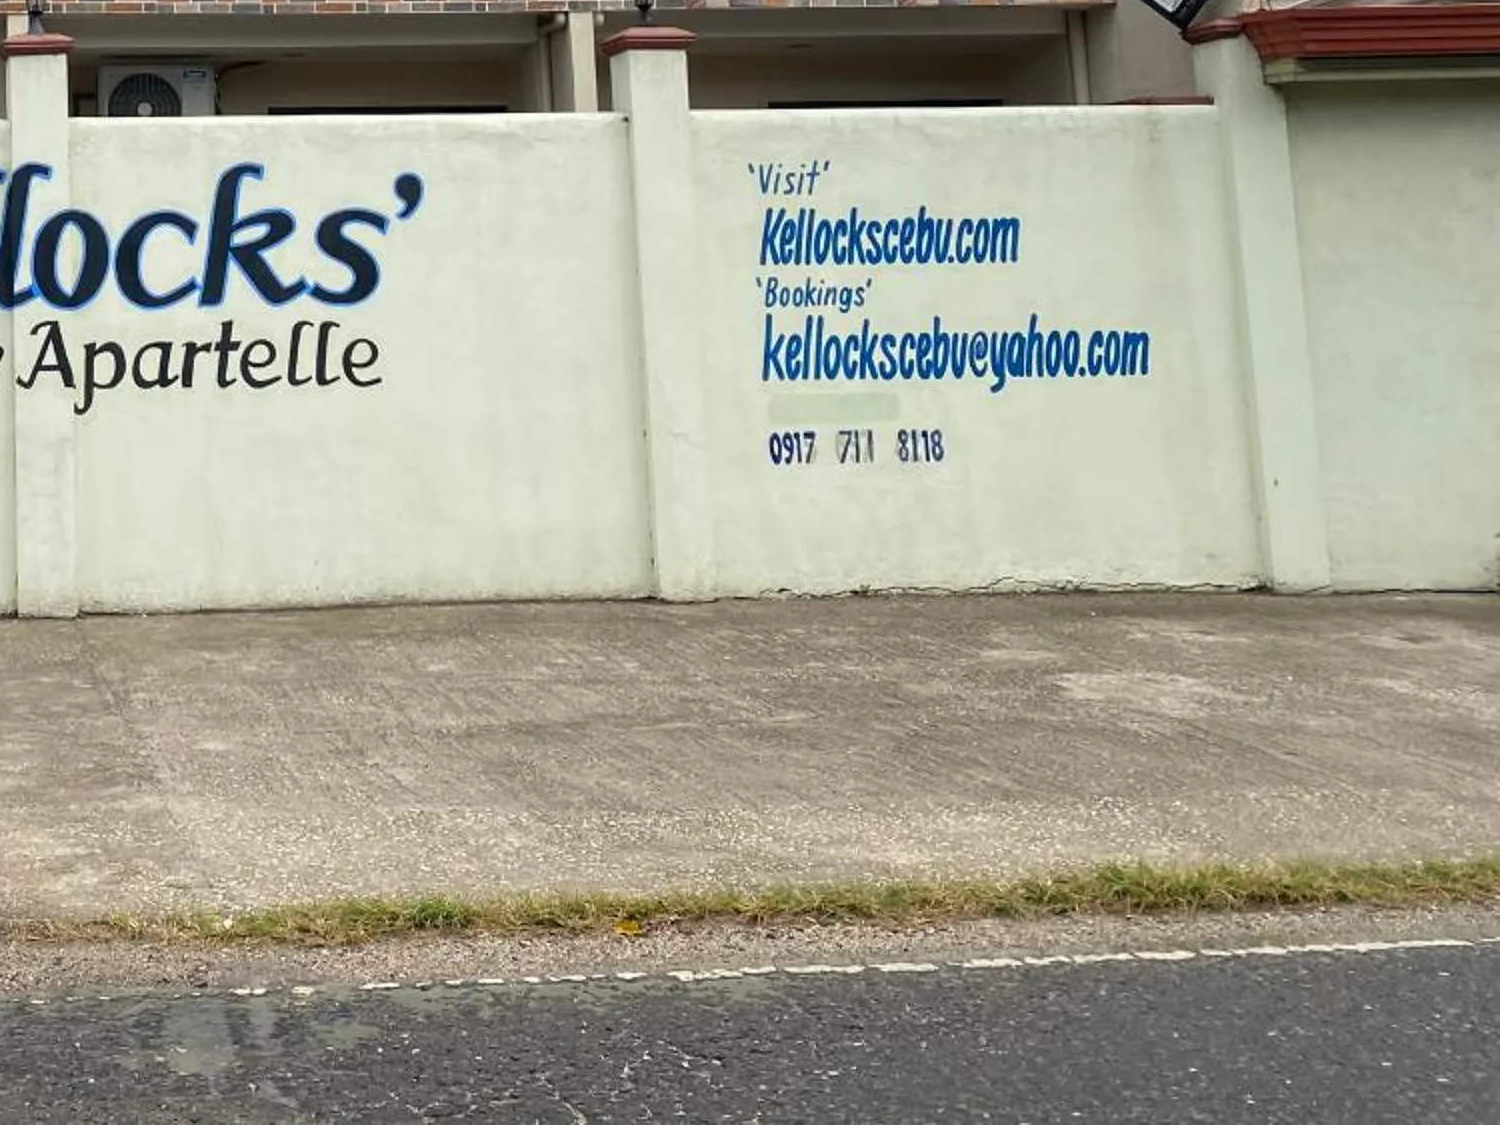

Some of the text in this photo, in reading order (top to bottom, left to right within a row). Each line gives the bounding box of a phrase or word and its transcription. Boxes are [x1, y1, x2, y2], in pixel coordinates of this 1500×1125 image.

[759, 206, 1021, 265] Kellockscebu.com
[16, 320, 382, 416] Apartelle
[762, 313, 1150, 393] kellockscebu@yahoo.com
[769, 430, 816, 465] 0917
